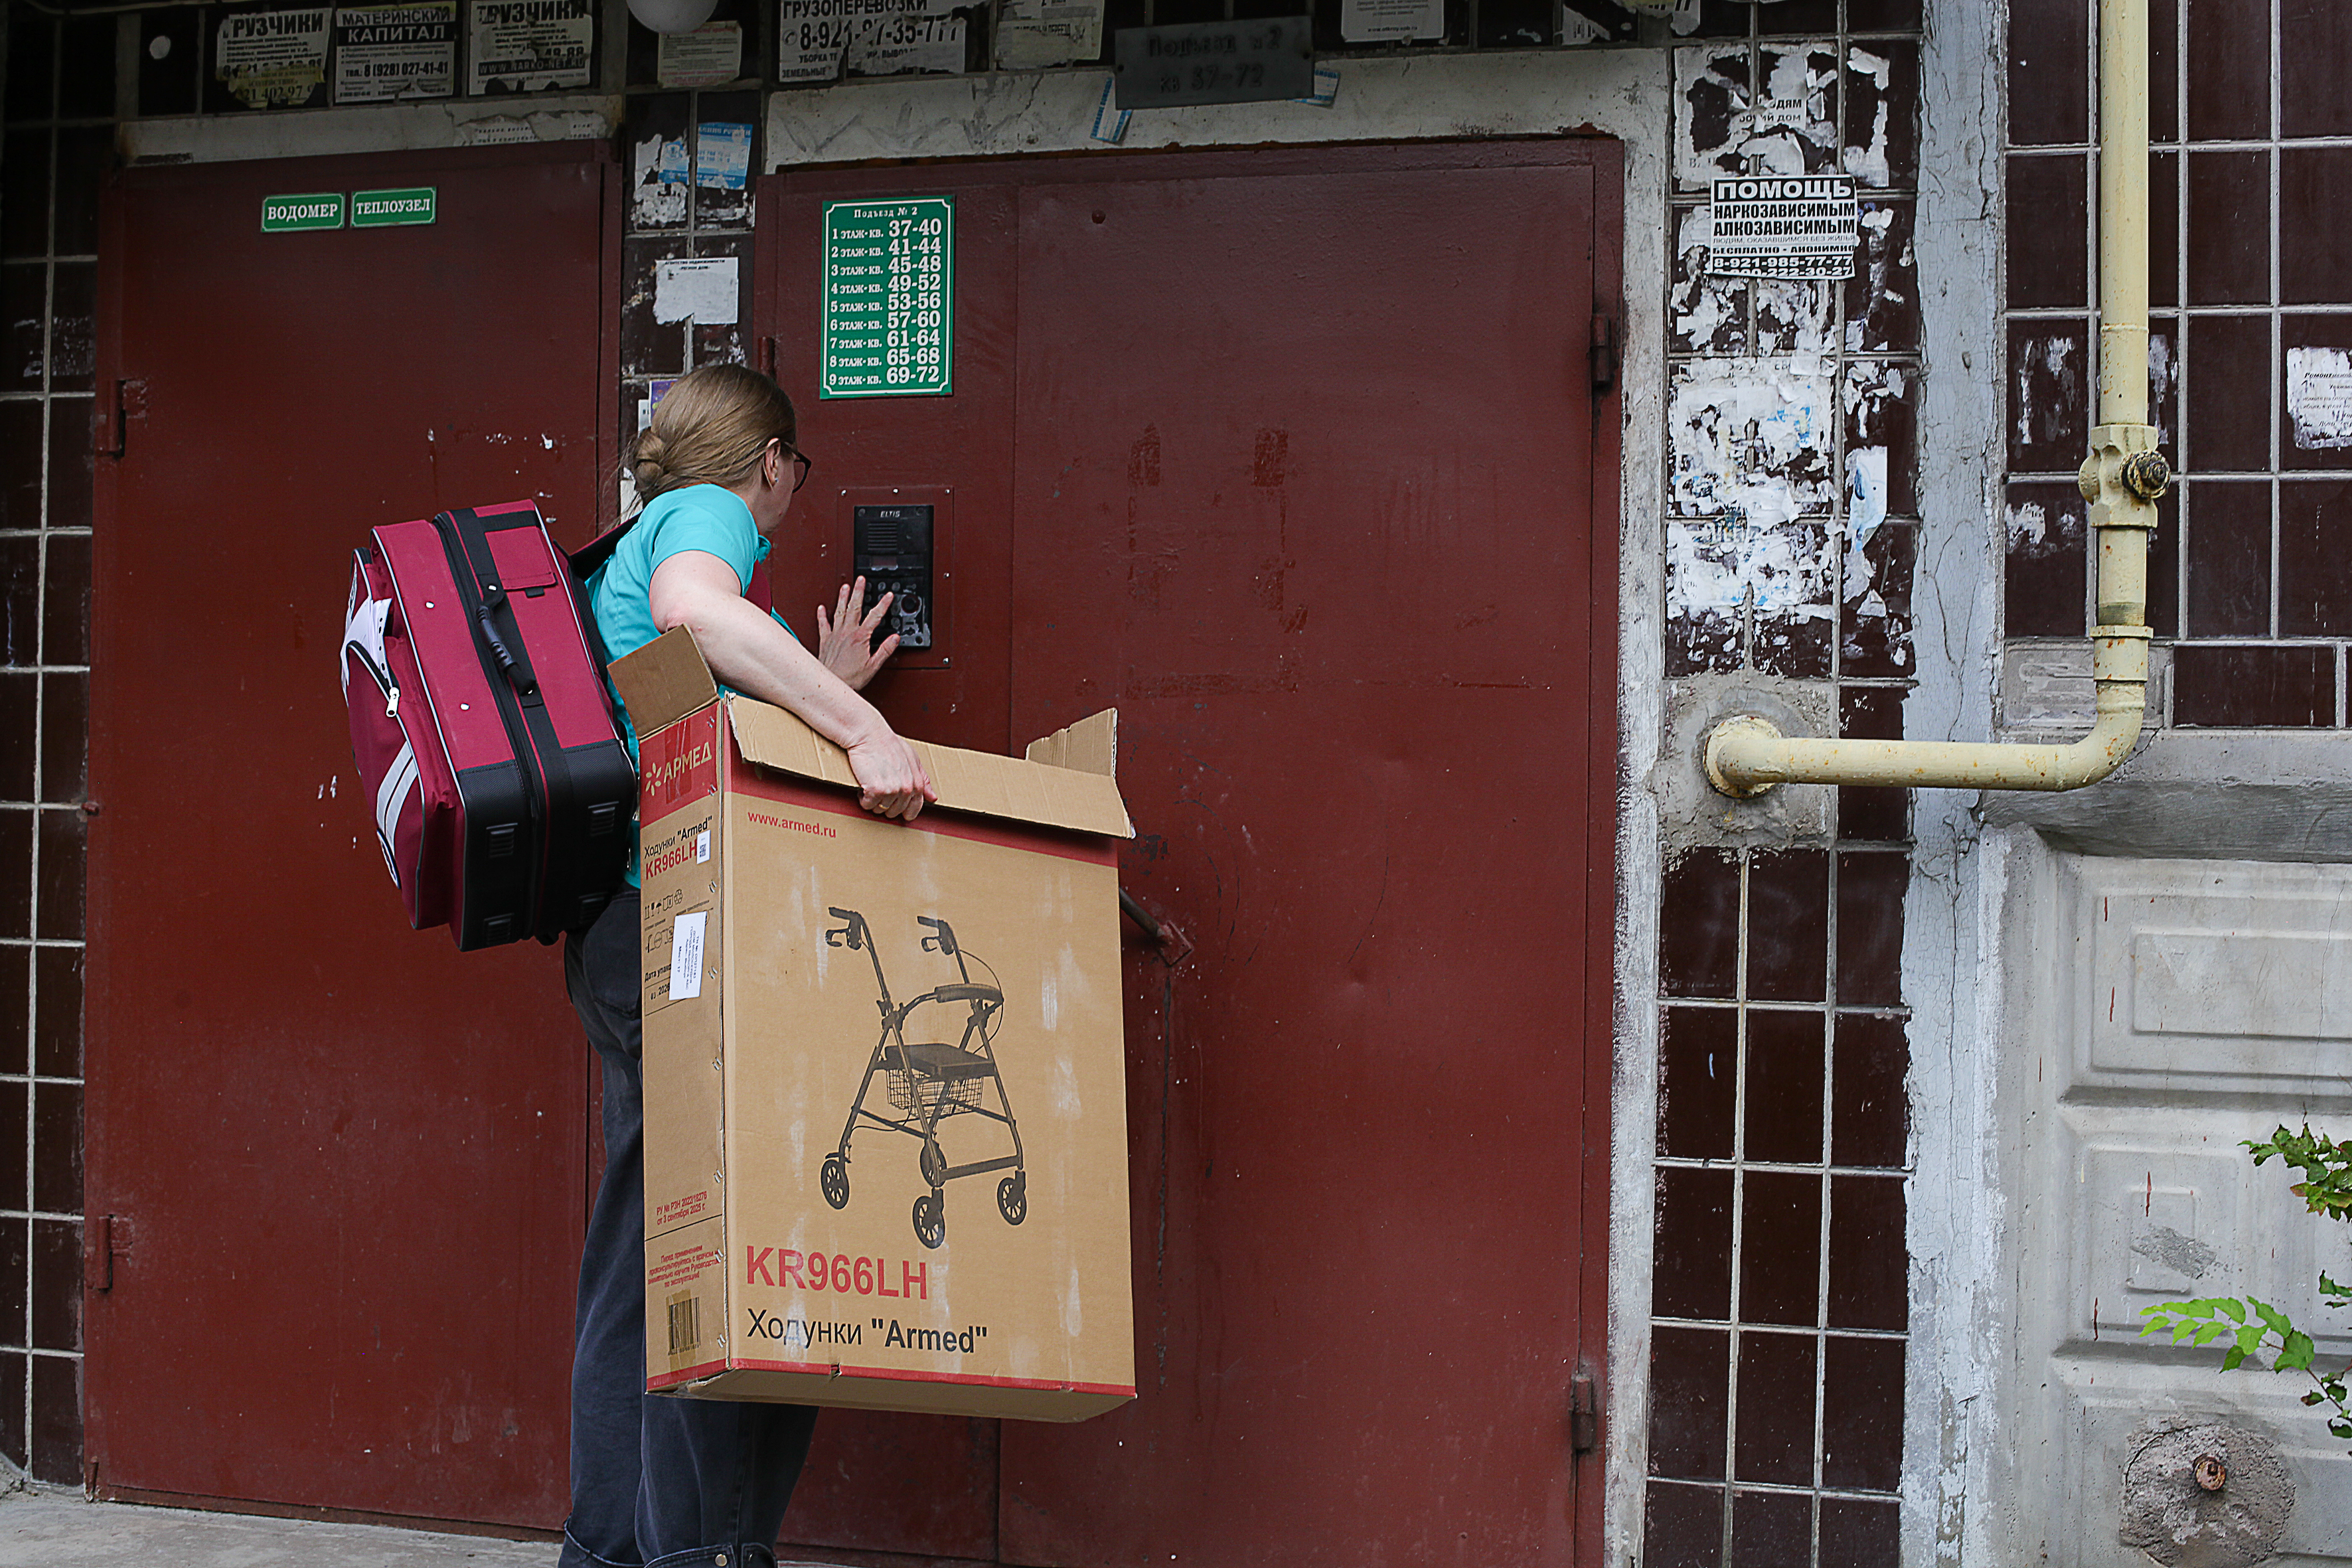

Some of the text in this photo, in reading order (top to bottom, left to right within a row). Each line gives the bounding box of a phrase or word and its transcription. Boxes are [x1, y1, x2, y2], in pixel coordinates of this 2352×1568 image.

[343, 8, 450, 25] МАТЕРИНСКИЙ
[348, 25, 445, 43] КАПИТАЛ
[364, 64, 371, 77] 8
[372, 63, 400, 76] (928)
[402, 61, 449, 75] 027-41-41
[1776, 114, 1801, 123] дом
[1717, 180, 1852, 200] ПОМОЩЬ
[267, 203, 338, 222] ВОДОМЕР
[356, 198, 431, 215] ТЕПЛОУЗЕЛ
[854, 209, 894, 218] Подъезд
[911, 206, 917, 215] 2
[1714, 202, 1855, 219] НАРКОЗАВИСИМЫМ
[832, 228, 838, 240] 1
[888, 218, 942, 237] 37-40
[1713, 219, 1855, 236] АЛКОЗАВИСИМЫМ
[831, 246, 838, 258] 2
[888, 237, 941, 255] 41-44
[830, 264, 838, 276] 3
[888, 255, 941, 274] 45-48
[1714, 257, 1853, 268] 8-921-985-77-77
[830, 282, 838, 294] 4
[888, 274, 941, 292] 49-52
[830, 300, 838, 313] 5
[888, 292, 941, 310] 53-56
[830, 319, 838, 331] 6
[888, 310, 941, 329] 57-60
[830, 337, 838, 349] 7
[887, 329, 941, 347] 61-64
[829, 355, 837, 368] 8
[886, 347, 940, 366] 65-68
[829, 373, 836, 385] 9
[886, 366, 939, 384] 69-72
[664, 741, 712, 783] АРМЕД
[747, 812, 836, 838] www.armed.ru
[645, 836, 675, 859] Ходунки
[677, 815, 712, 842] "Armed"
[645, 838, 697, 880] KR966LH
[645, 971, 657, 983] Дата
[747, 1245, 927, 1300] KR966LH
[747, 1308, 862, 1349] Ходунки
[872, 1317, 988, 1354] "Armed"
